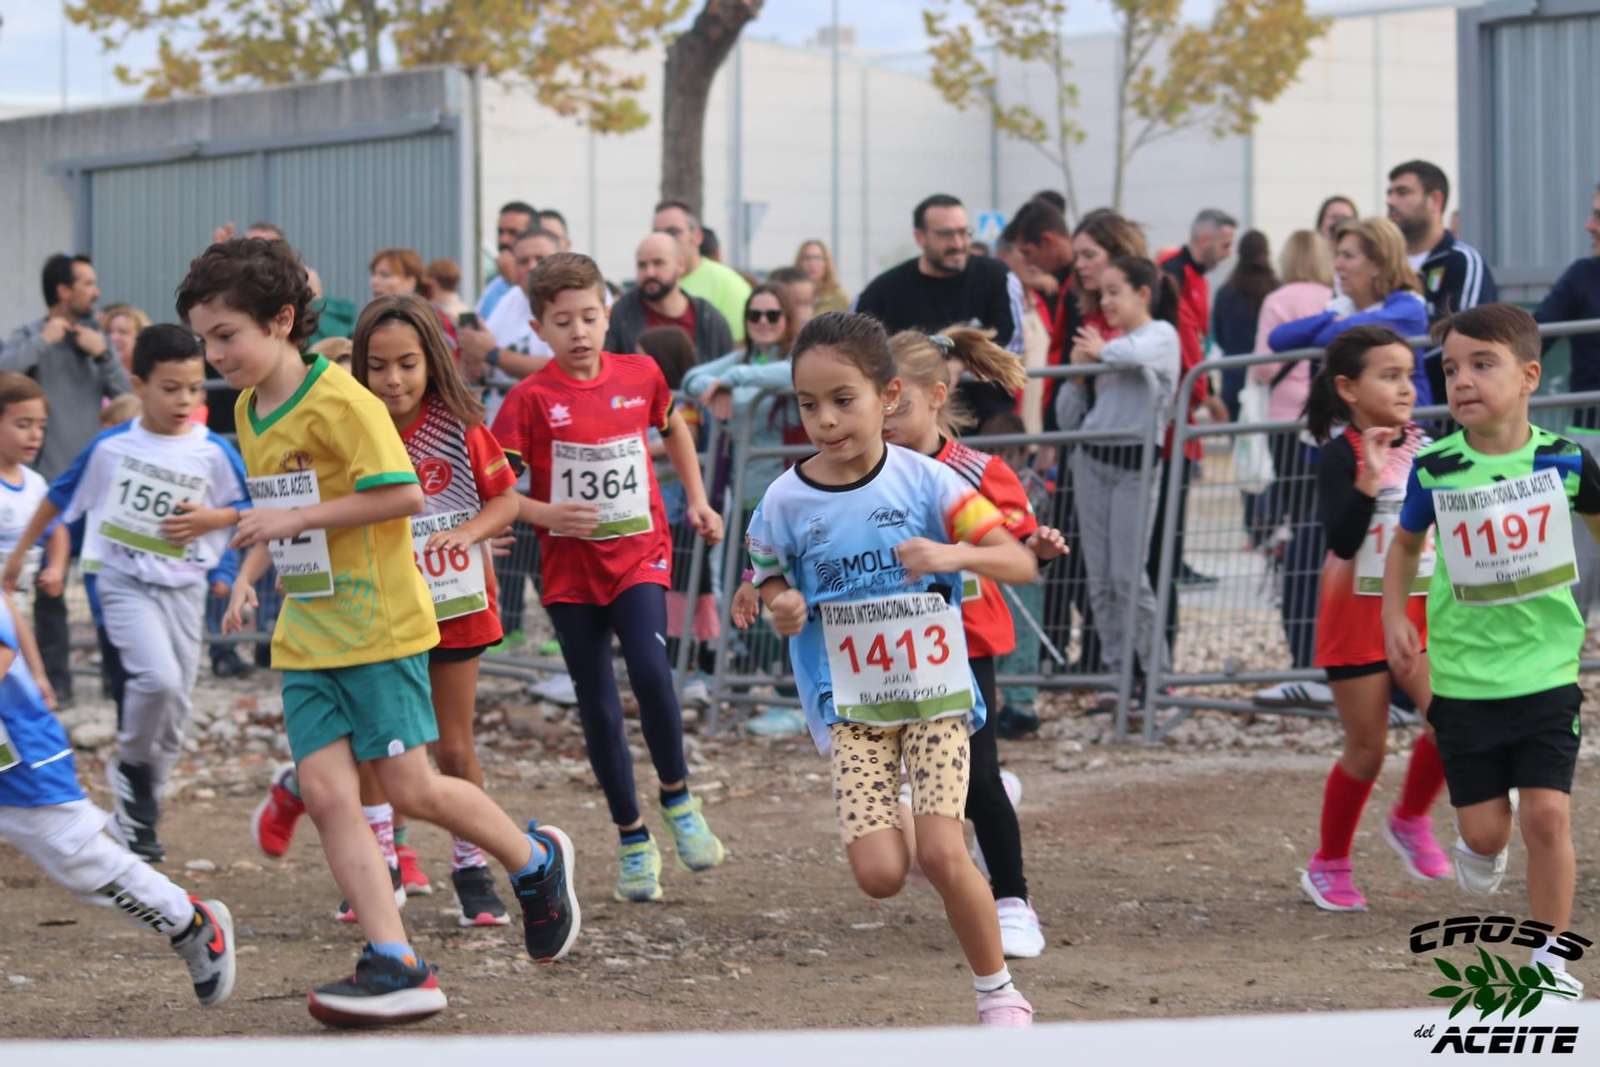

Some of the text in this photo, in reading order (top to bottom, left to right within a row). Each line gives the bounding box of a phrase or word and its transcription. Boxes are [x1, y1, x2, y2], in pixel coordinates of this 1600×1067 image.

[561, 464, 639, 501] 1364
[1446, 491, 1468, 512] CROSS
[1515, 480, 1532, 499] DEL
[1530, 473, 1556, 497] ACEITE
[1452, 503, 1552, 558] 1197
[841, 547, 903, 578] MOLI
[1496, 566, 1531, 582] Daniel
[434, 577, 459, 588] Navas
[832, 604, 856, 626] CROSS
[855, 597, 914, 626] INTERNACIONAL
[839, 623, 951, 675] 1413
[882, 673, 912, 687] JULIA
[912, 683, 948, 700] POLO
